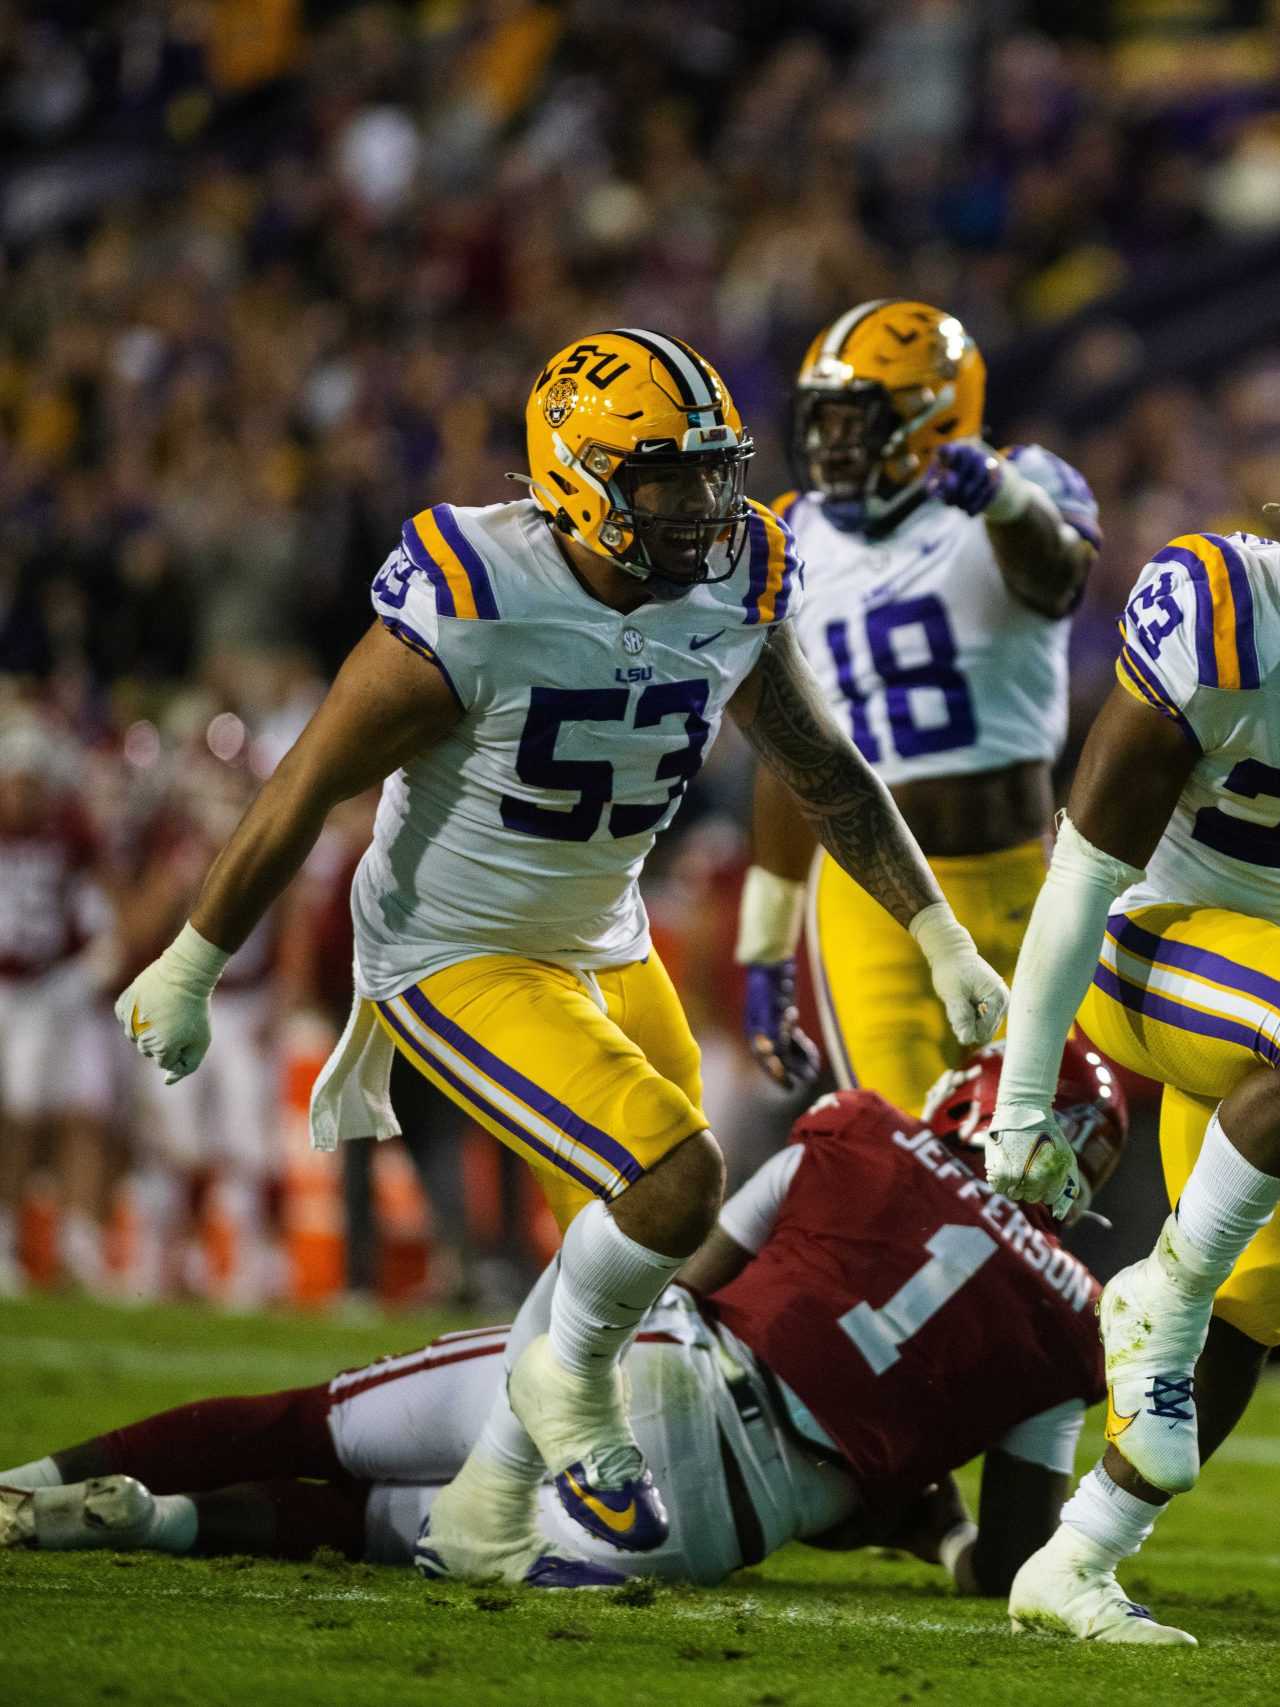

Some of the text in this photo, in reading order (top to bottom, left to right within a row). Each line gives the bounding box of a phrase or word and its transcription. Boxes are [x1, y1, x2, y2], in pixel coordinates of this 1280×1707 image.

[615, 666, 652, 683] LSU
[827, 594, 977, 764] 18
[500, 679, 710, 842] 53
[837, 1223, 998, 1376] 1
